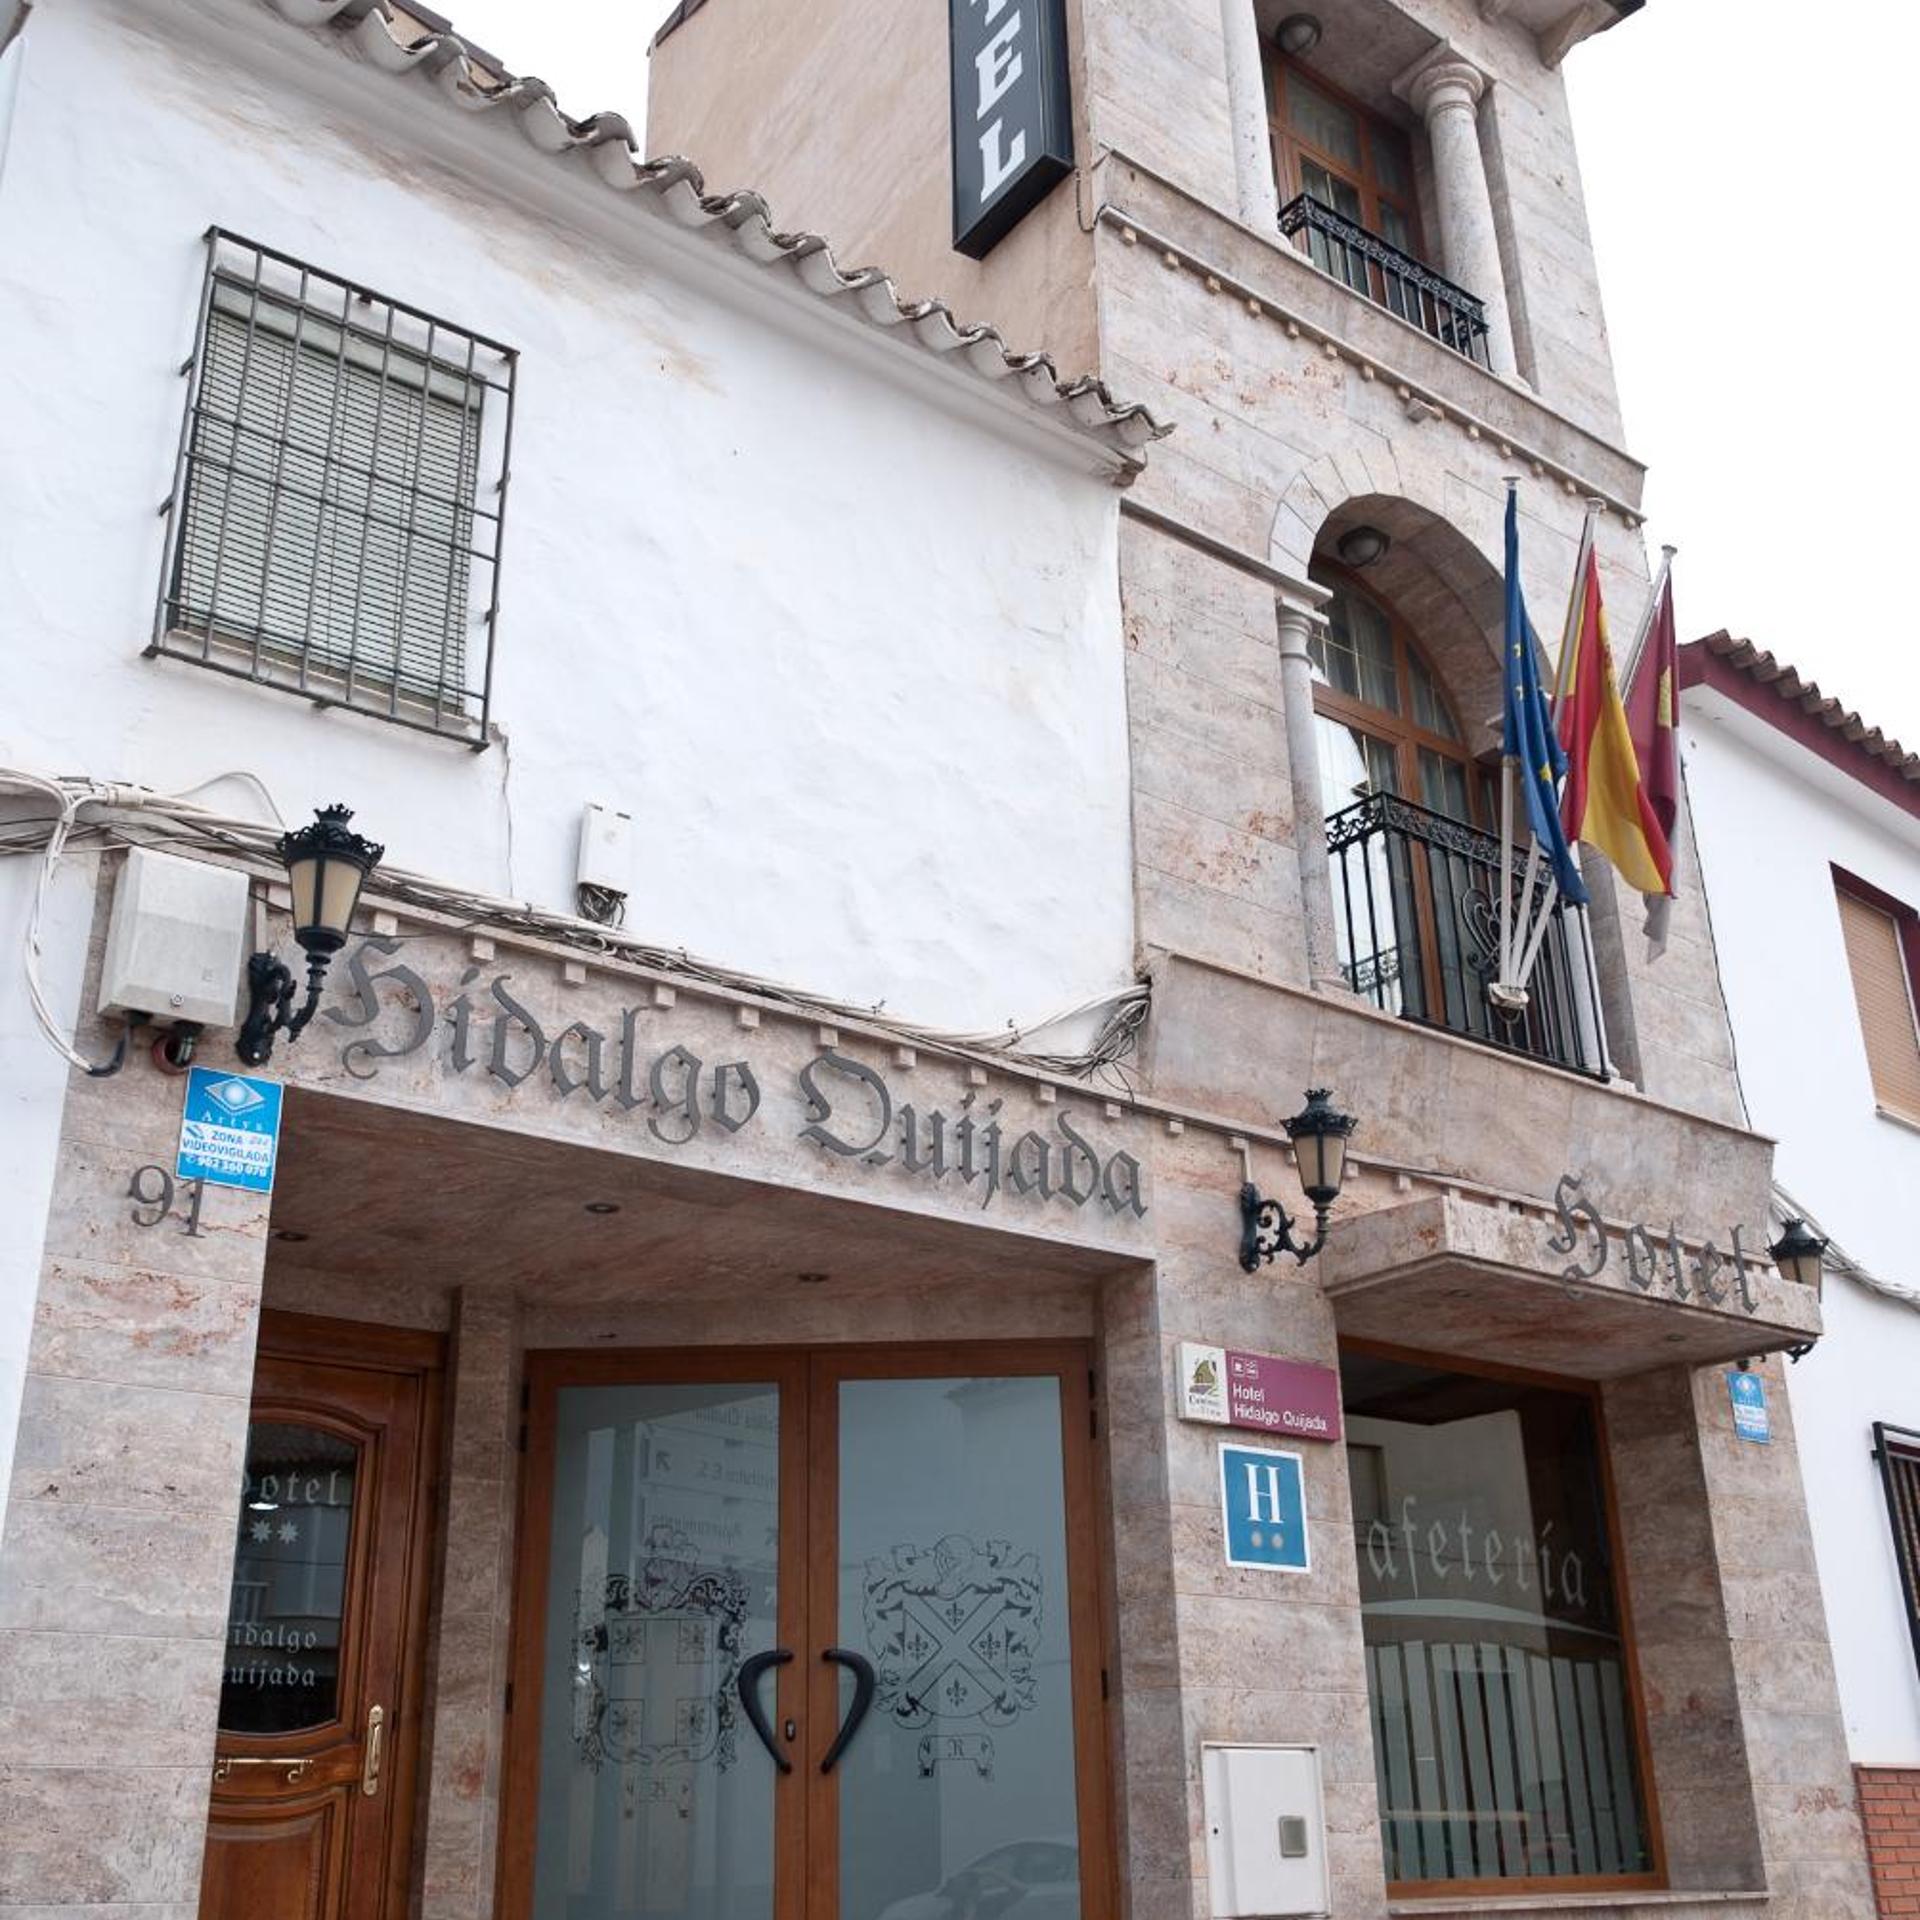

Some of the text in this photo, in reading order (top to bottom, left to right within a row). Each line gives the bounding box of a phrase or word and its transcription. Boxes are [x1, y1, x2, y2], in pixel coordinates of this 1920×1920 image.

[322, 937, 1148, 1220] Hidalgo Quijada
[182, 1137, 271, 1163] VIDEOVIGILADA
[211, 1131, 244, 1145] ZONA
[127, 1165, 206, 1239] 91
[1547, 1174, 1760, 1315] Hotel
[1232, 1384, 1265, 1402] Hotel
[1234, 1403, 1279, 1425] Hidalgo
[1282, 1409, 1327, 1433] Quijada
[1243, 1462, 1284, 1524] H
[1366, 1495, 1588, 1608] afetería
[232, 1623, 318, 1653] idalgo
[223, 1659, 317, 1690] uijada
